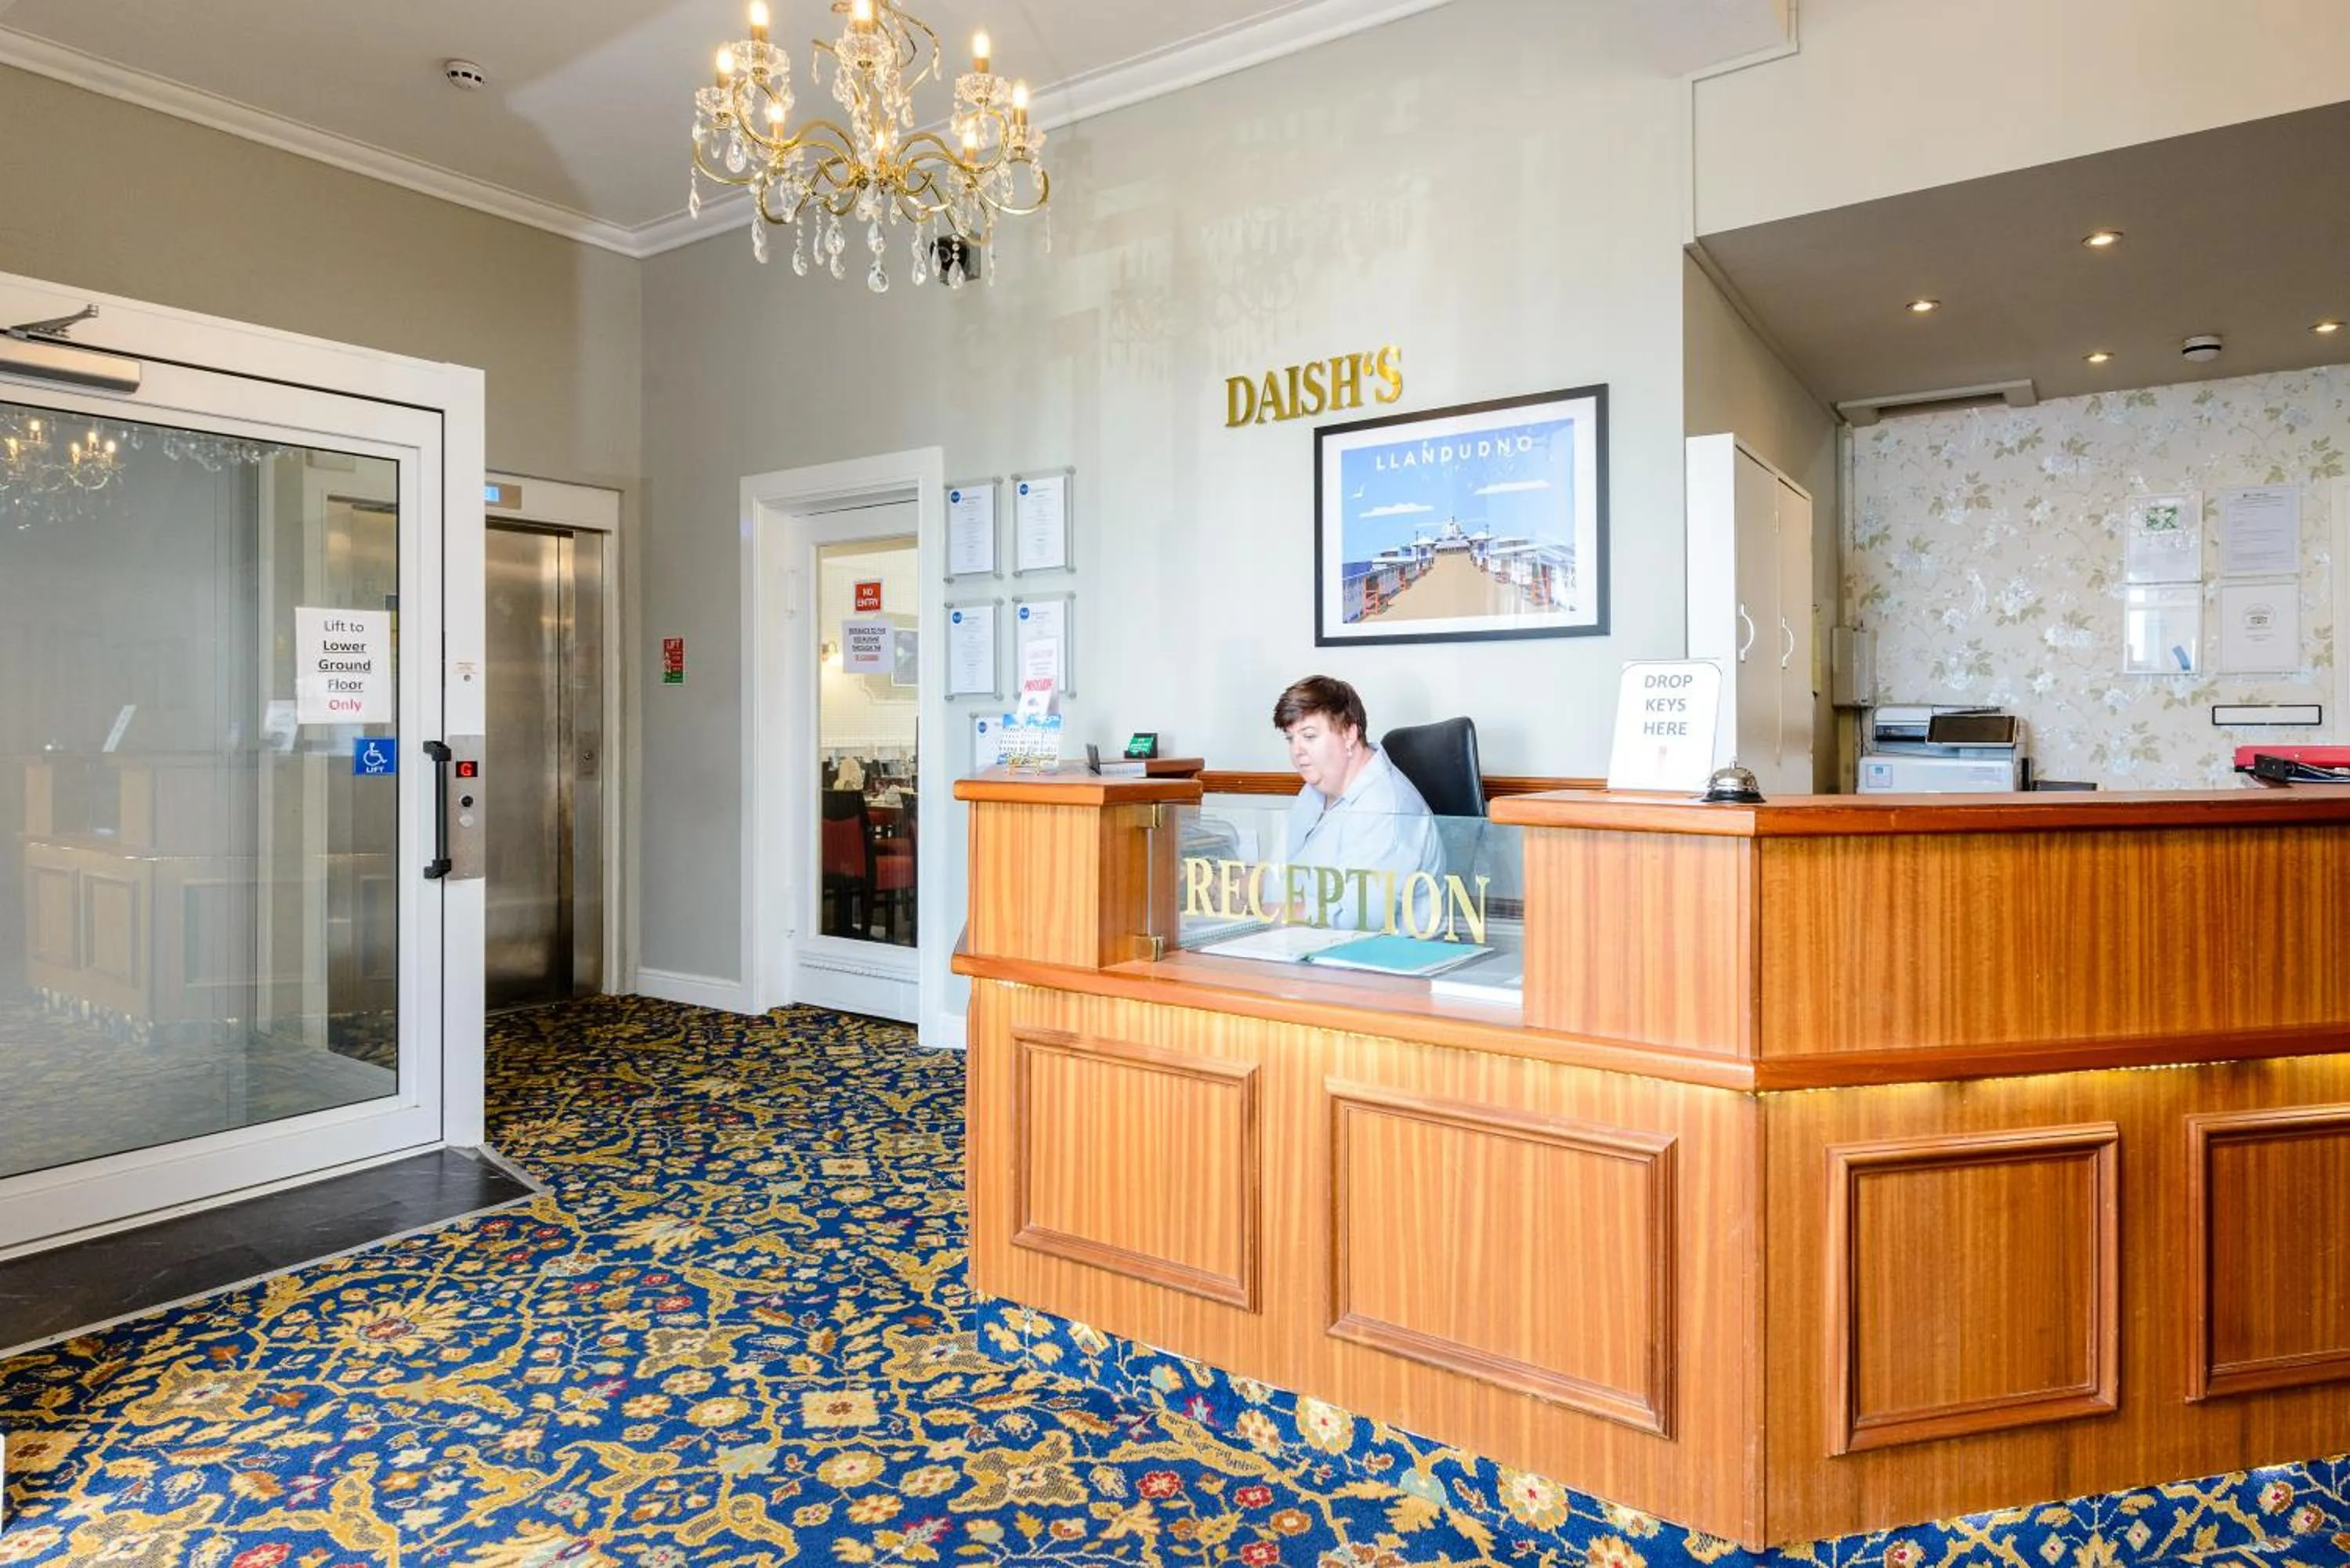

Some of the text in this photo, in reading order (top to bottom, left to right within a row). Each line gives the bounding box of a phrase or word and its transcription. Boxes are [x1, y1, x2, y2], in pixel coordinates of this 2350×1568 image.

[1225, 345, 1403, 428] DAISH'S
[1376, 435, 1533, 471] LLANDUDNO
[862, 587, 874, 597] NO
[857, 598, 878, 607] ENTRY
[324, 620, 364, 633] Lift to
[323, 640, 367, 652] Lower
[318, 659, 371, 671] Ground
[327, 678, 363, 690] Floor
[1644, 674, 1693, 688] DROP
[328, 698, 362, 712] Only
[1646, 697, 1687, 713] KEYS
[1643, 721, 1688, 735] HERE
[1184, 857, 1491, 945] RECEPTION
